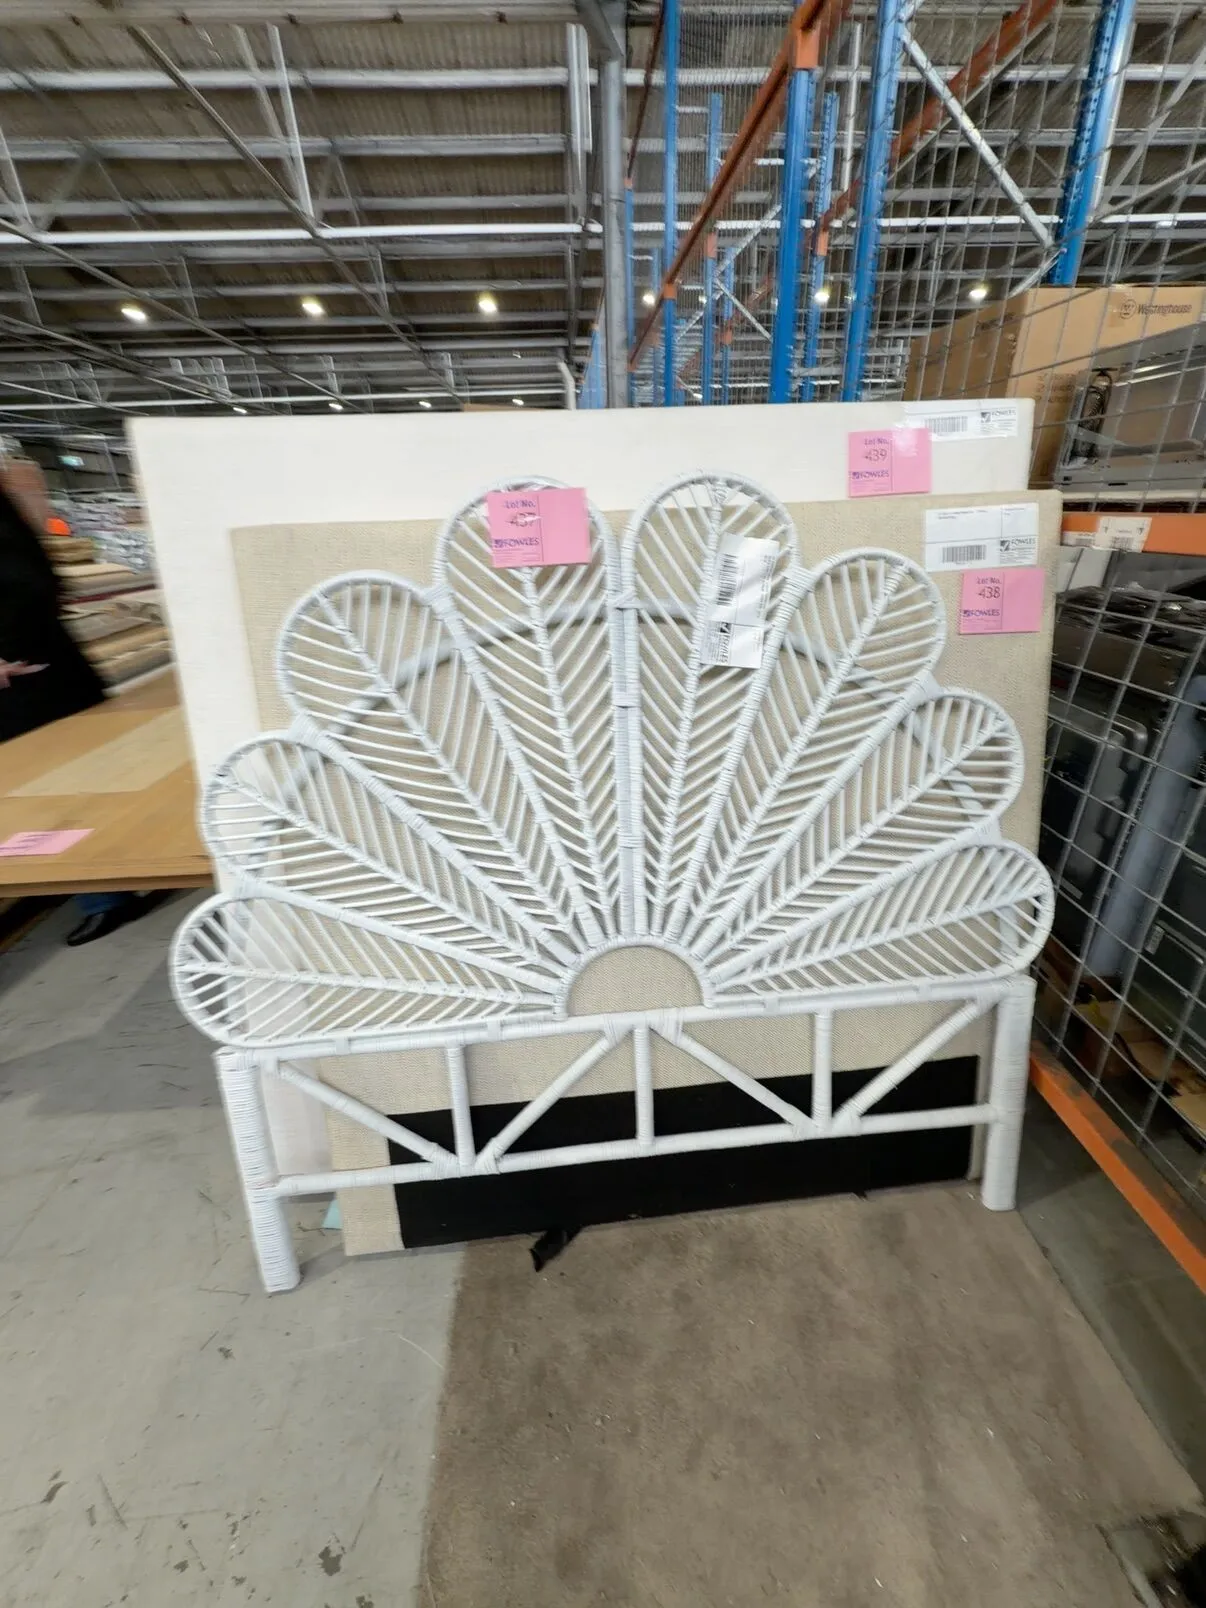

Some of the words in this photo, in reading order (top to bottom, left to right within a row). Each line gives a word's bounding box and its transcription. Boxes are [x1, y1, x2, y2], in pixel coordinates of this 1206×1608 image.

[1137, 303, 1193, 315] Westinghouse
[977, 577, 988, 585] Lot
[977, 586, 1001, 599] 438
[970, 609, 1000, 617] FOWLES
